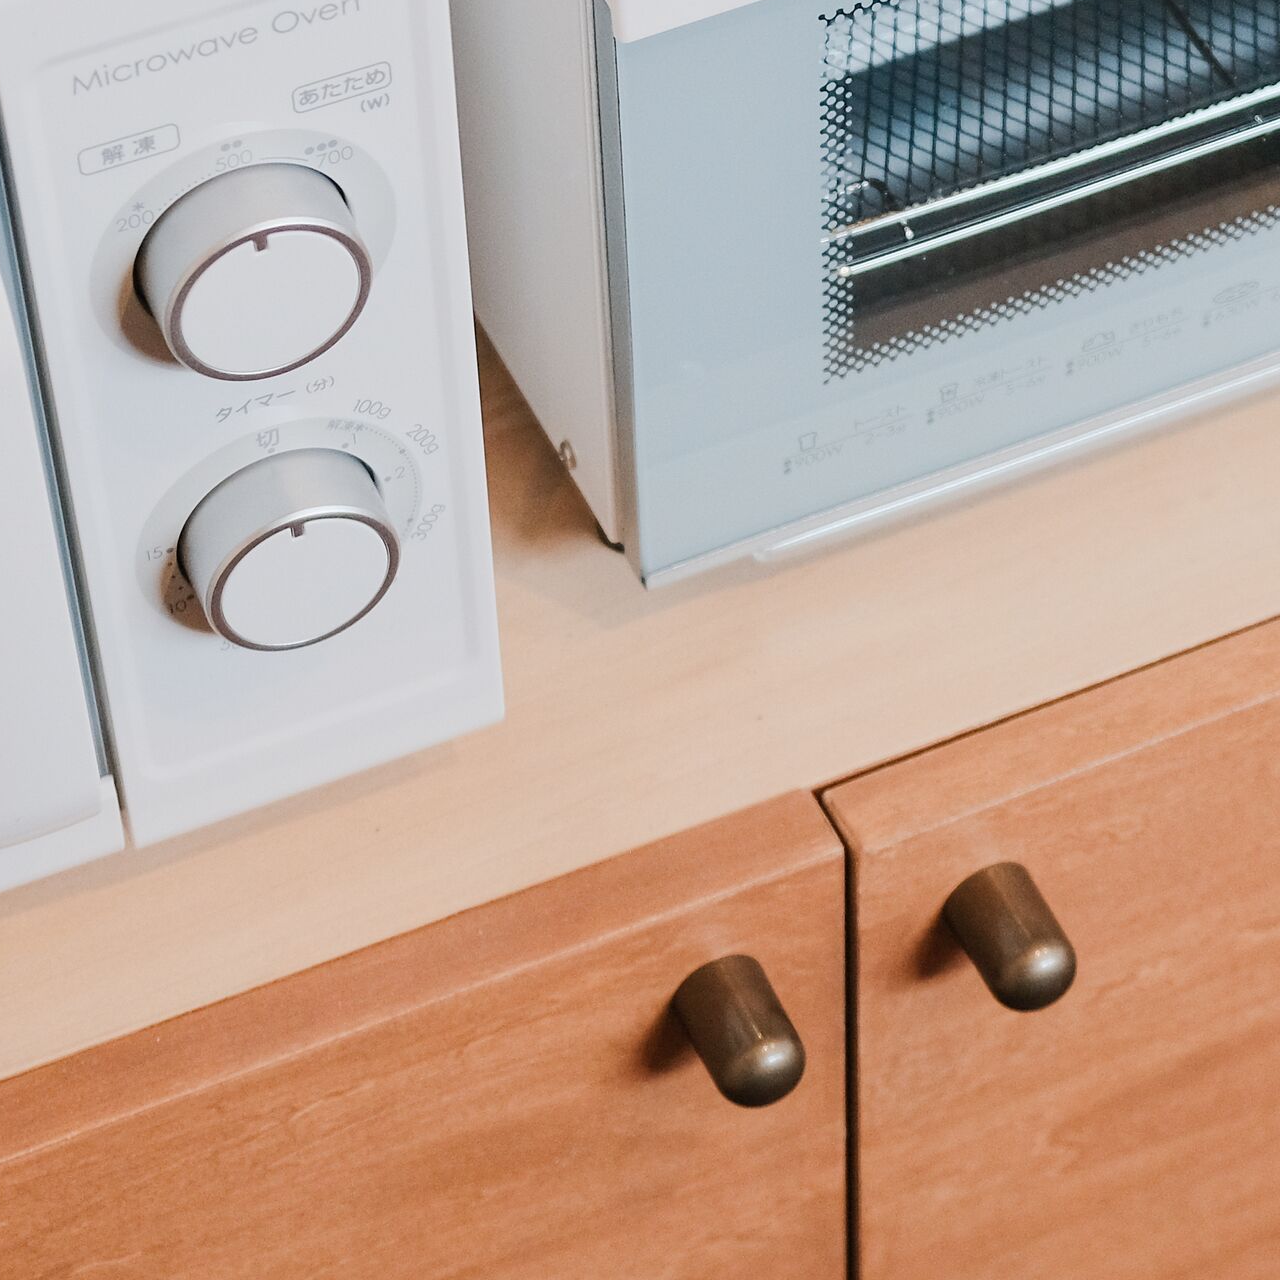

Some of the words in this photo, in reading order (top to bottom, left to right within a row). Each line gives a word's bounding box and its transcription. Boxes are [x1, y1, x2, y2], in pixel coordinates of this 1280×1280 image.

[72, 27, 259, 96] Microwave
[298, 68, 386, 107] あたため
[216, 149, 252, 172] 500
[319, 145, 354, 168] 700
[117, 209, 155, 233] 200
[216, 389, 297, 423] タイマー
[352, 399, 392, 419] 100g
[256, 427, 280, 449] 切
[405, 423, 439, 455] 200g
[410, 503, 446, 541] 300g
